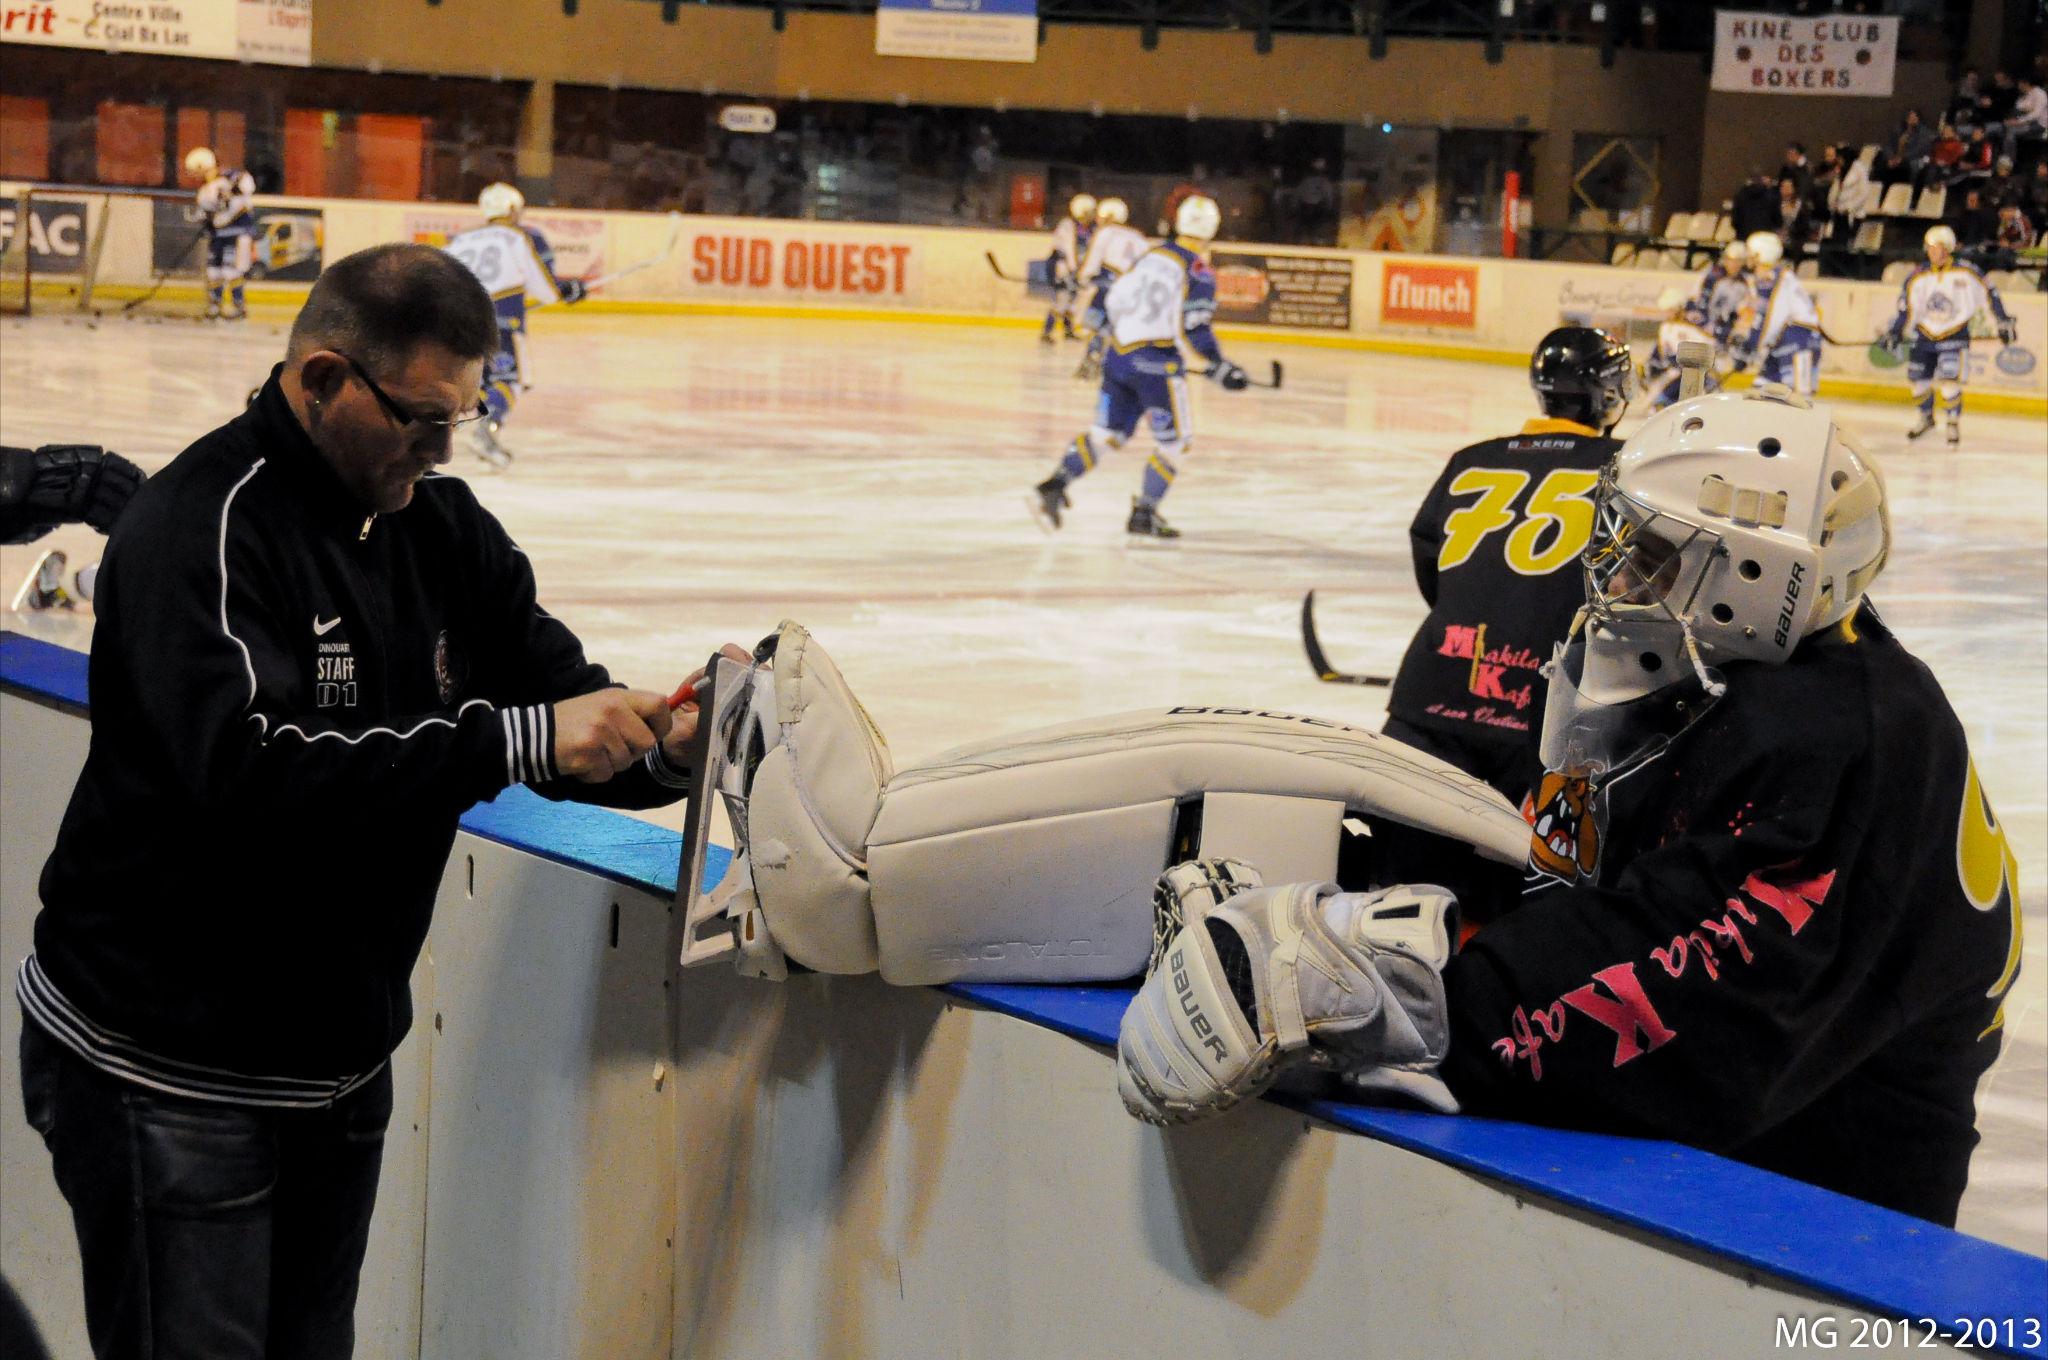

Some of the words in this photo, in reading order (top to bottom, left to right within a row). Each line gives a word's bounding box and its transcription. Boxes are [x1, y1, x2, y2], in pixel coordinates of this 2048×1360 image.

[0, 4, 56, 34] rit
[1814, 22, 1880, 43] CLUB
[1778, 43, 1825, 63] DES
[1752, 67, 1850, 89] BOXERS
[692, 235, 774, 289] SUD
[783, 239, 911, 294] OUEST
[1389, 273, 1472, 312] flunch
[1437, 466, 1600, 576] 75
[1773, 562, 1806, 650] BAUER
[317, 657, 355, 681] STAFF
[316, 681, 357, 708] D1
[1169, 947, 1229, 1066] BAUER
